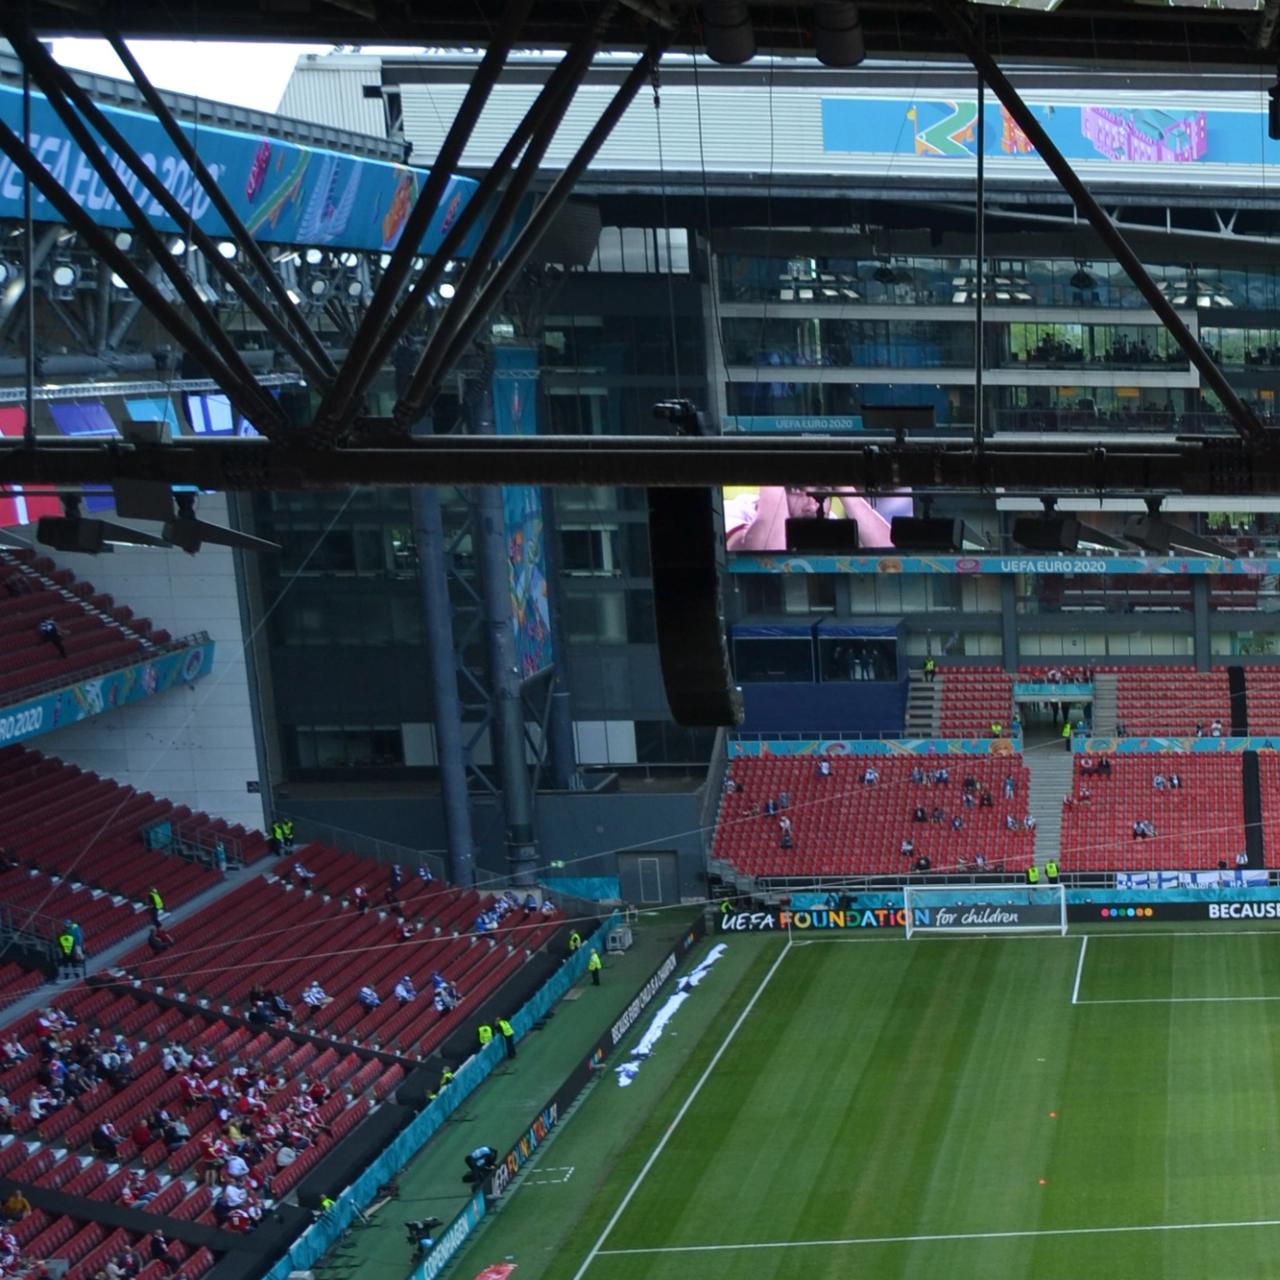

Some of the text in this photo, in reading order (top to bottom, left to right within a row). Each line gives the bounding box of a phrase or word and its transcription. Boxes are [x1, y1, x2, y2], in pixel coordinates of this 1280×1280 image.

[775, 419, 801, 429] UEFA
[828, 419, 853, 429] 2020
[1001, 560, 1106, 572] UEFA EURO 2020
[721, 912, 774, 930] UEFA
[935, 910, 958, 927] for
[961, 907, 1019, 924] children
